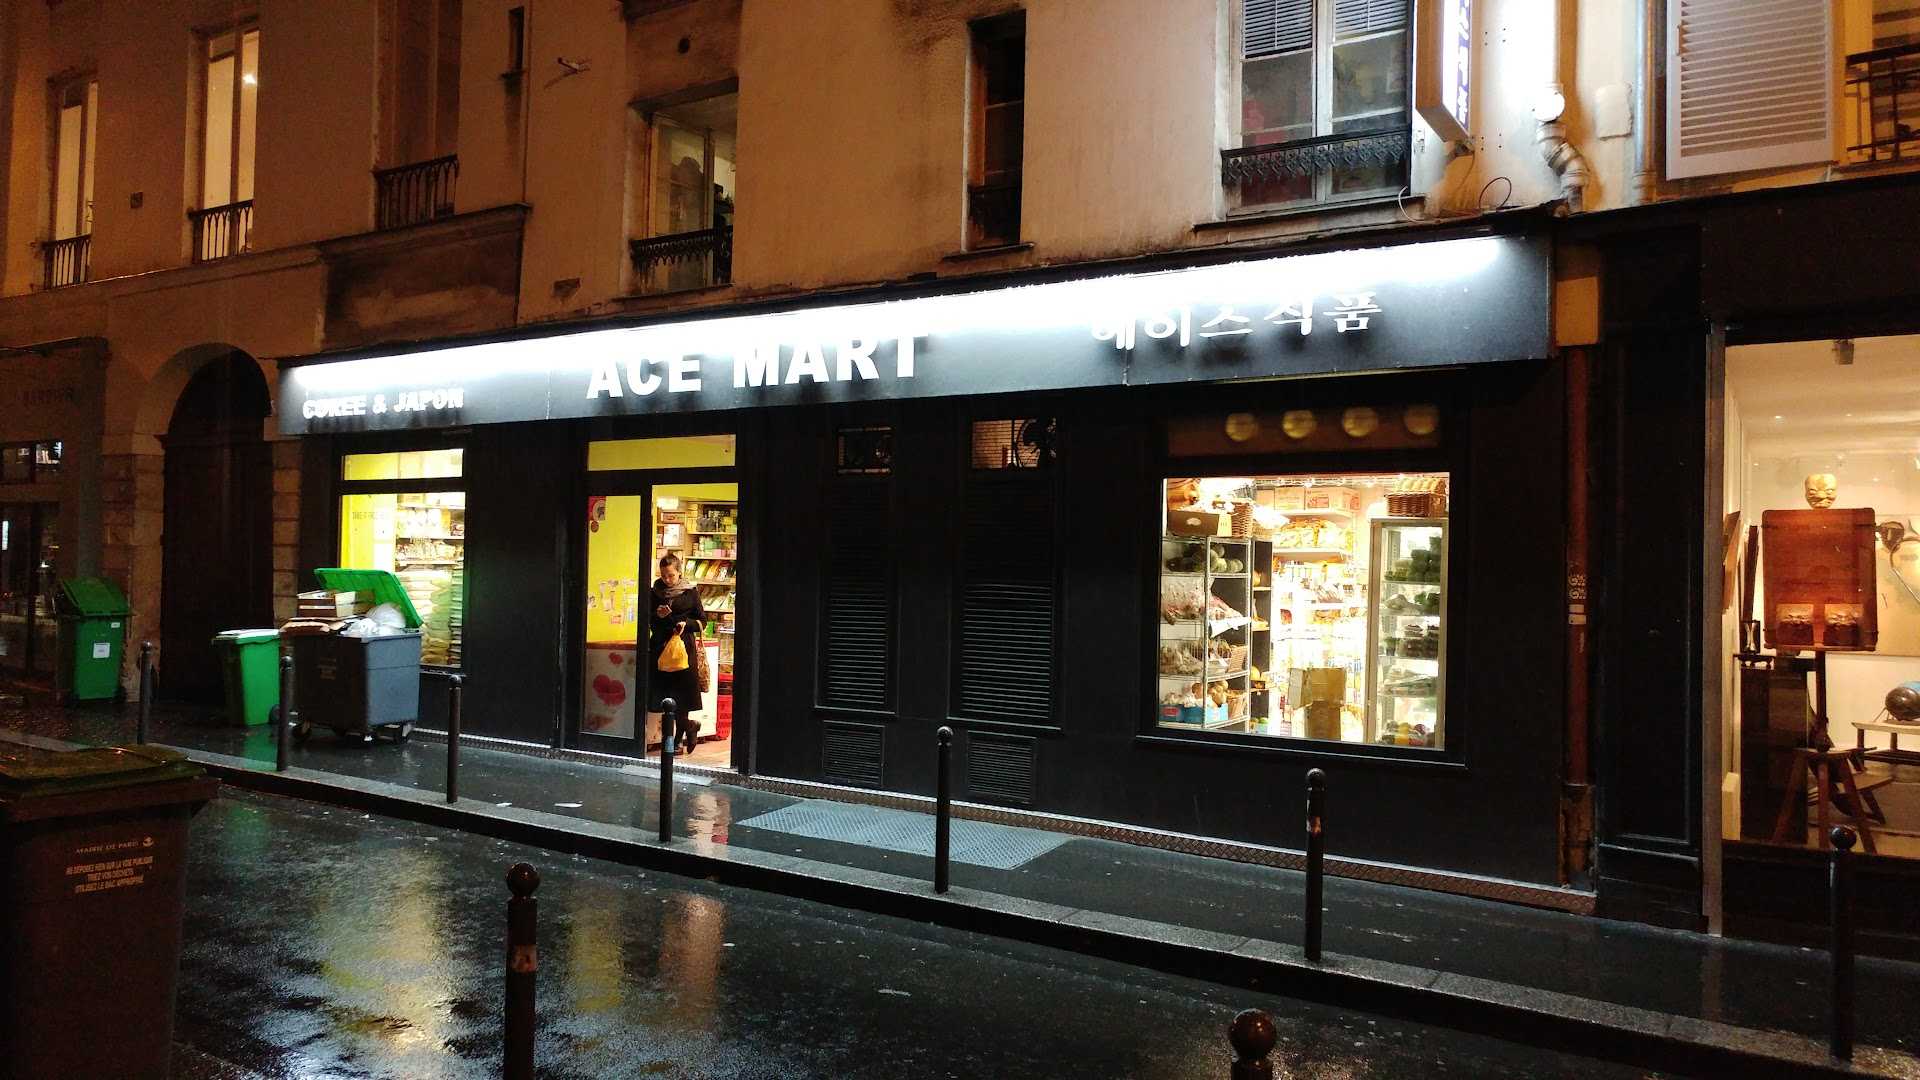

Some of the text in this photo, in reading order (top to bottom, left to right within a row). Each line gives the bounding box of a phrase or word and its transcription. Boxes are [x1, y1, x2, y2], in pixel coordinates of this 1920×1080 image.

[586, 328, 928, 399] ACE MART
[372, 393, 387, 414] &
[394, 388, 464, 412] JAPON
